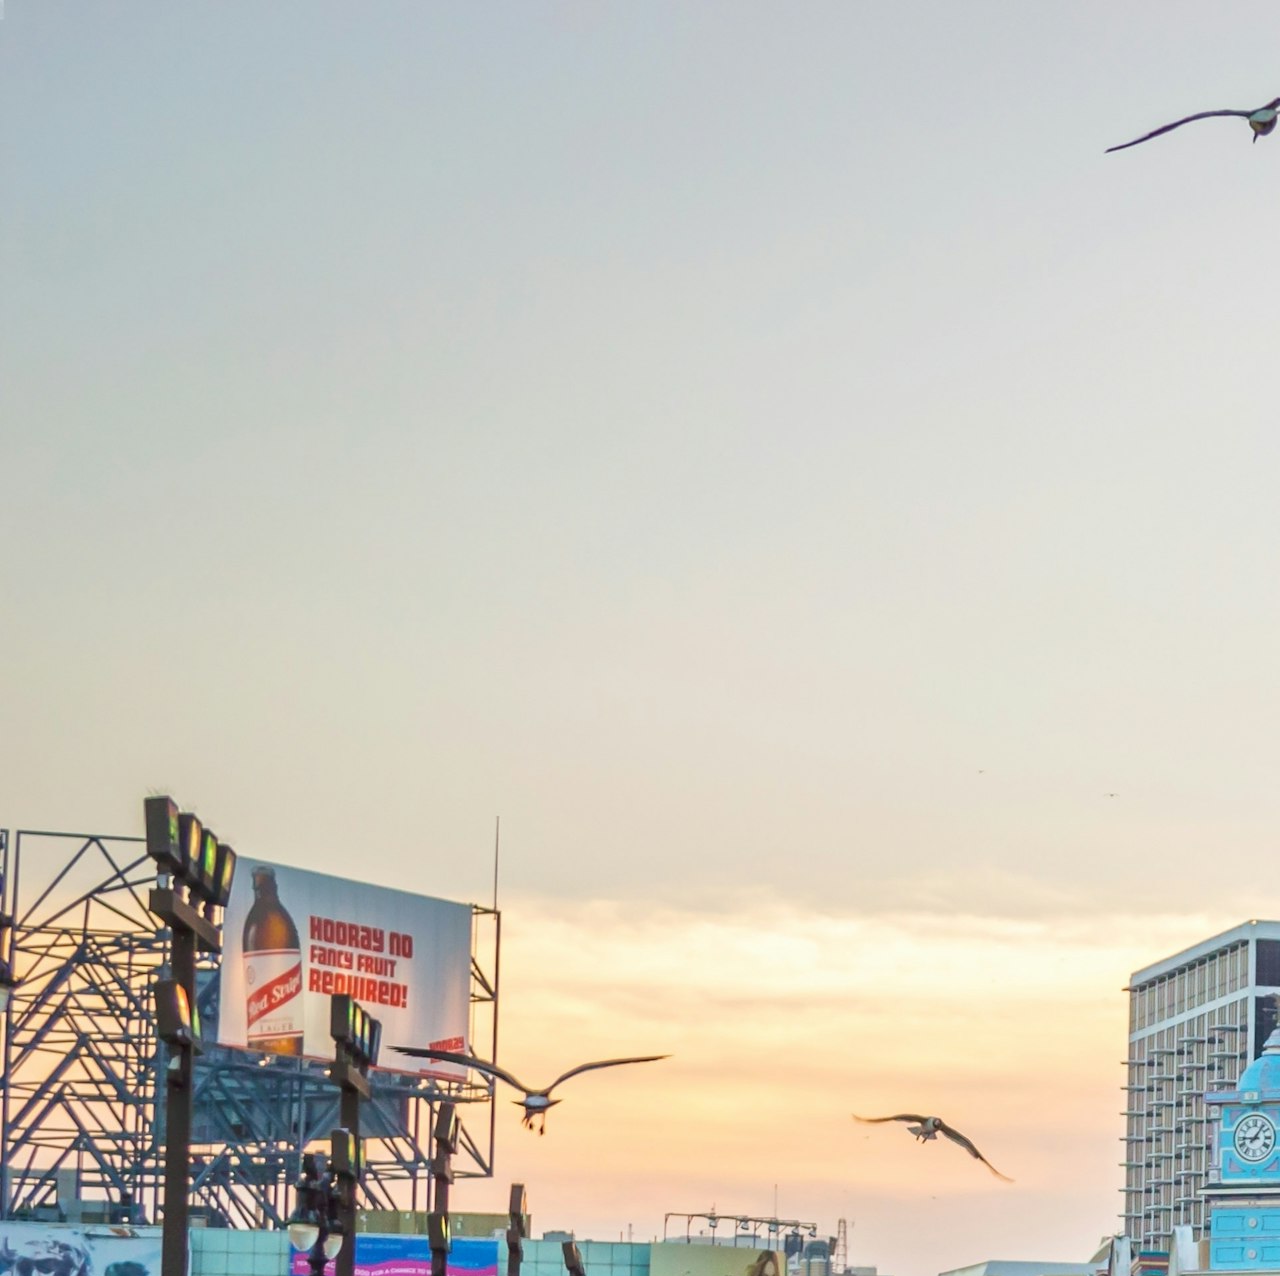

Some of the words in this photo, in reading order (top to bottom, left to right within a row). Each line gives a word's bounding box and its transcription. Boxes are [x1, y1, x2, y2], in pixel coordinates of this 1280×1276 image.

[309, 915, 384, 953] HOORAY
[389, 931, 413, 959] NO
[357, 953, 397, 977] FRUIT
